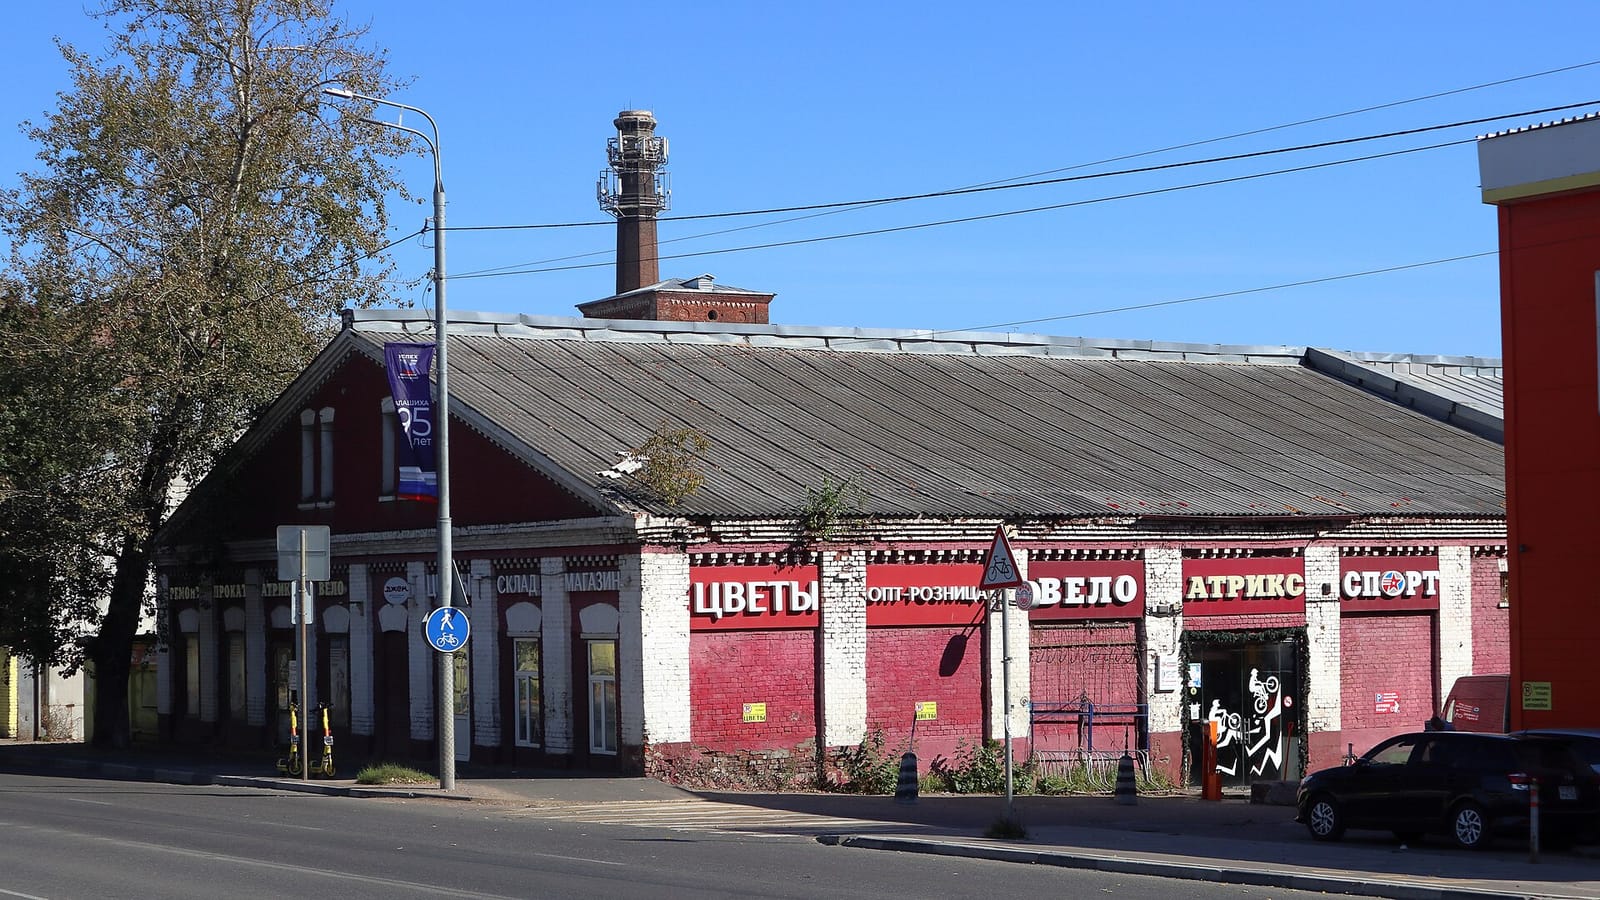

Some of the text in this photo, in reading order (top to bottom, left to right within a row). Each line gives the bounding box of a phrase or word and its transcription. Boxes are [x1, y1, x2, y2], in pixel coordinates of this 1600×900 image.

[261, 581, 291, 597] АТРИК
[318, 581, 345, 596] ВЕЛО
[496, 574, 538, 597] СКЛАД
[564, 571, 621, 592] МАГАЗИН
[1040, 575, 1137, 604] ВЕЛО
[1187, 573, 1305, 599] АТРИКС
[694, 580, 818, 618] ЦВЕТЫ
[868, 586, 988, 603] ОПТ-РОЗНИЦА
